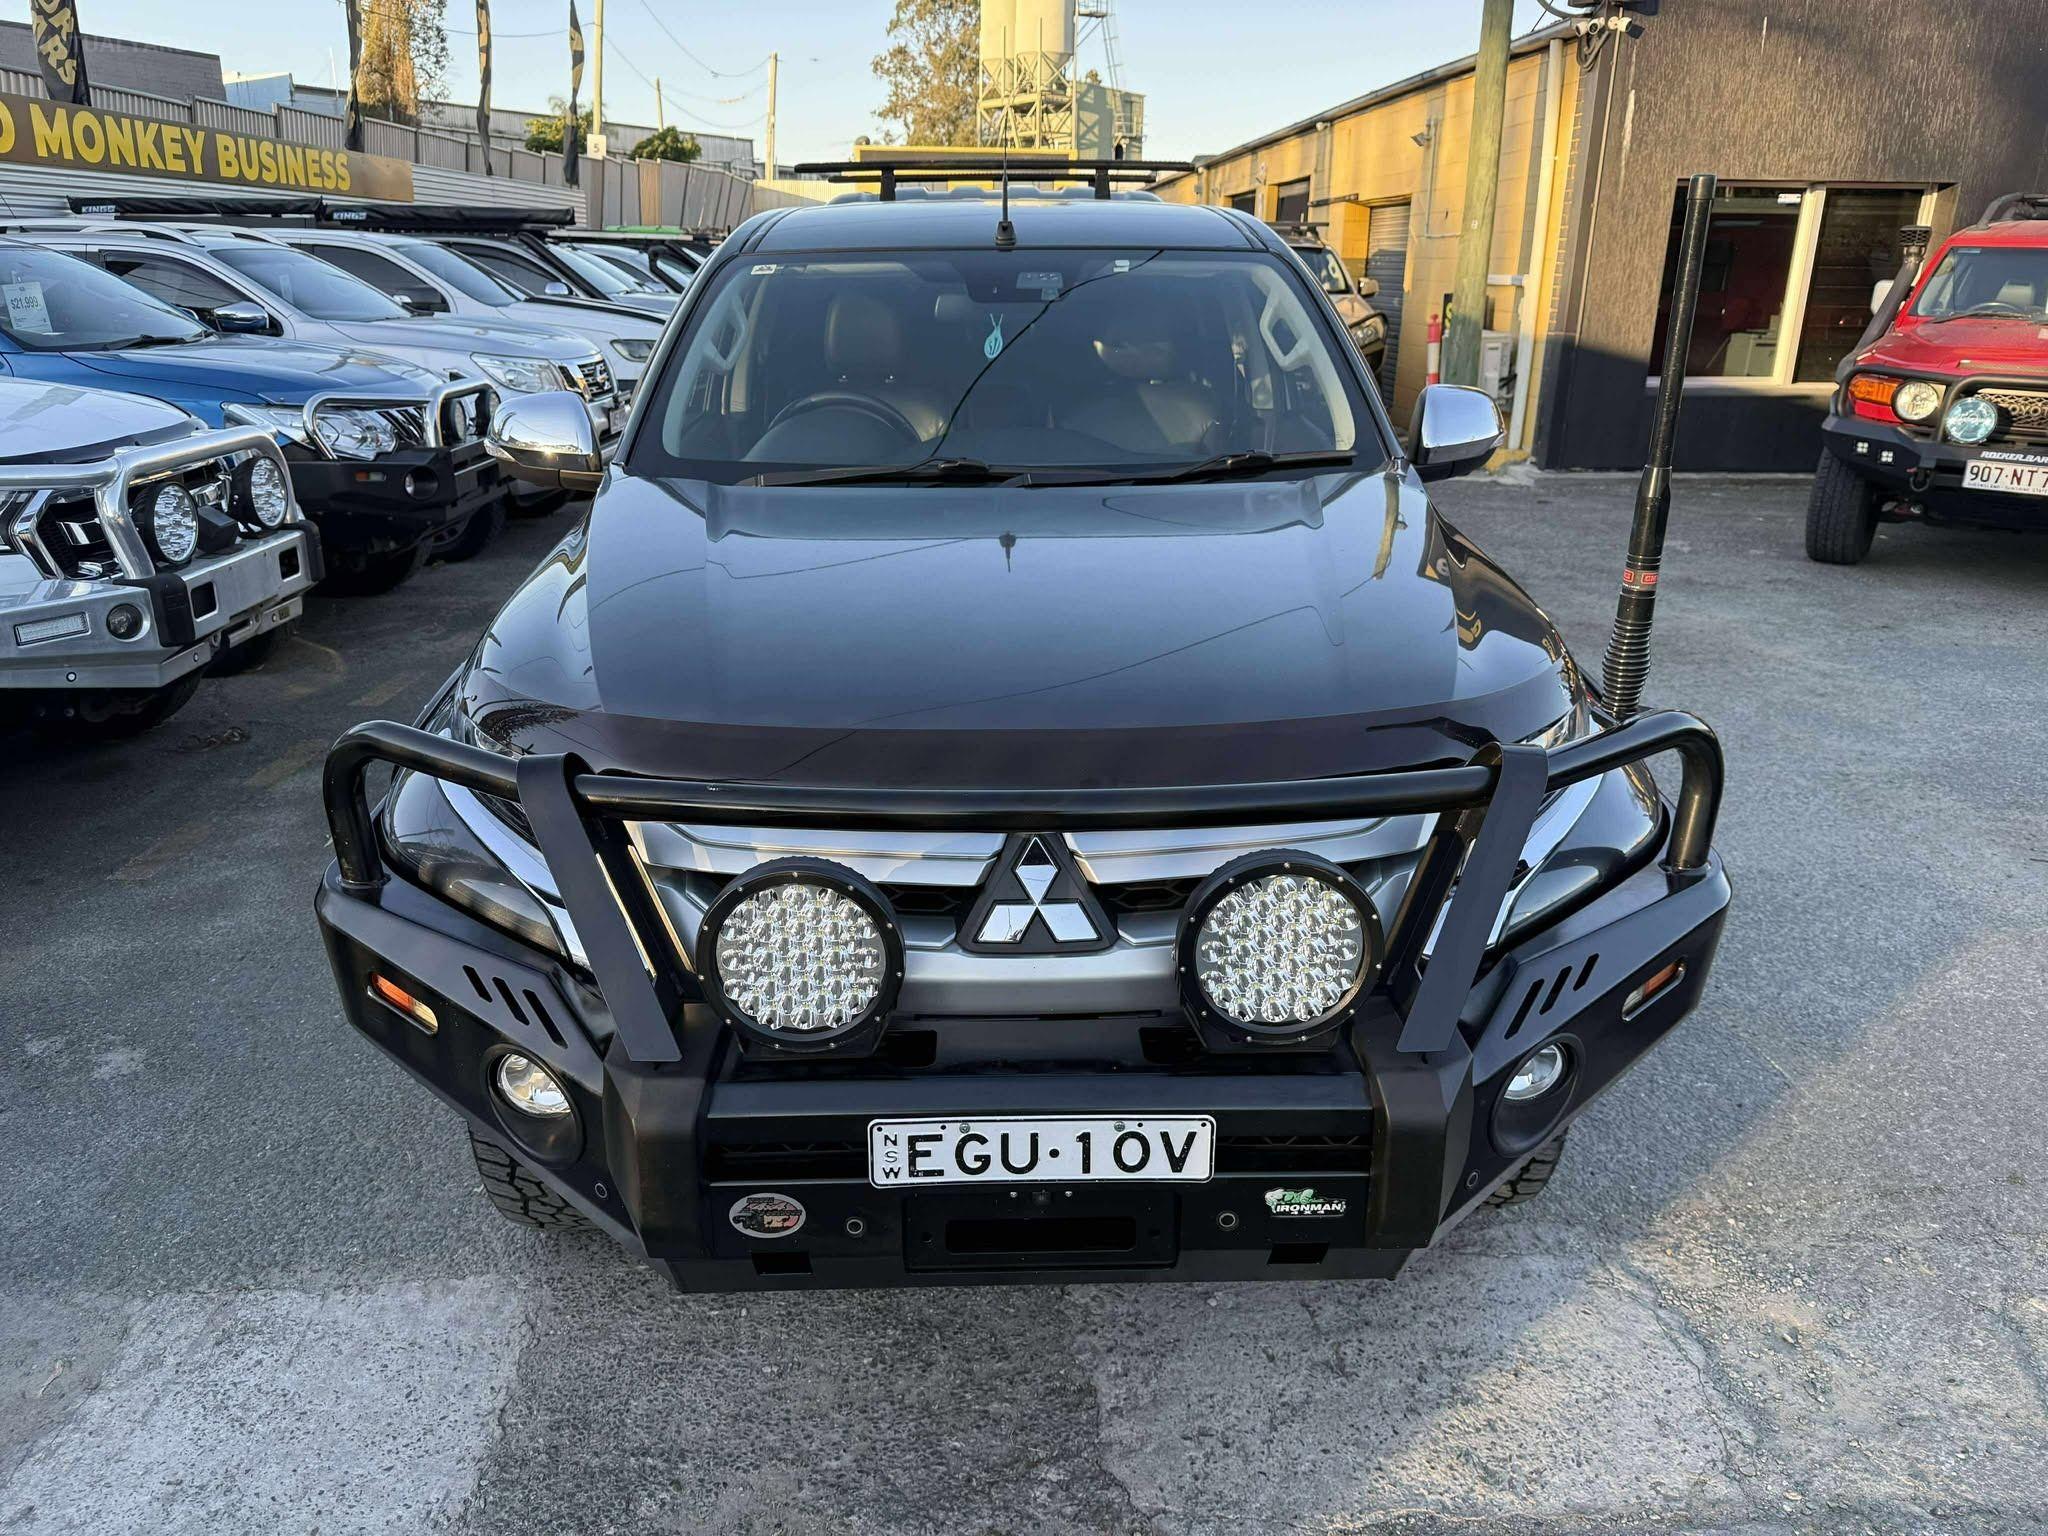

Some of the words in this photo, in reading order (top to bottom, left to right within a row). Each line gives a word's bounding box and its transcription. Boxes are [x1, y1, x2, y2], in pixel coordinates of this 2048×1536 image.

[29, 103, 206, 174] MONKEY
[215, 133, 351, 191] BUSINESS
[593, 143, 600, 153] 5
[1276, 1203, 1341, 1212] IRONMAN
